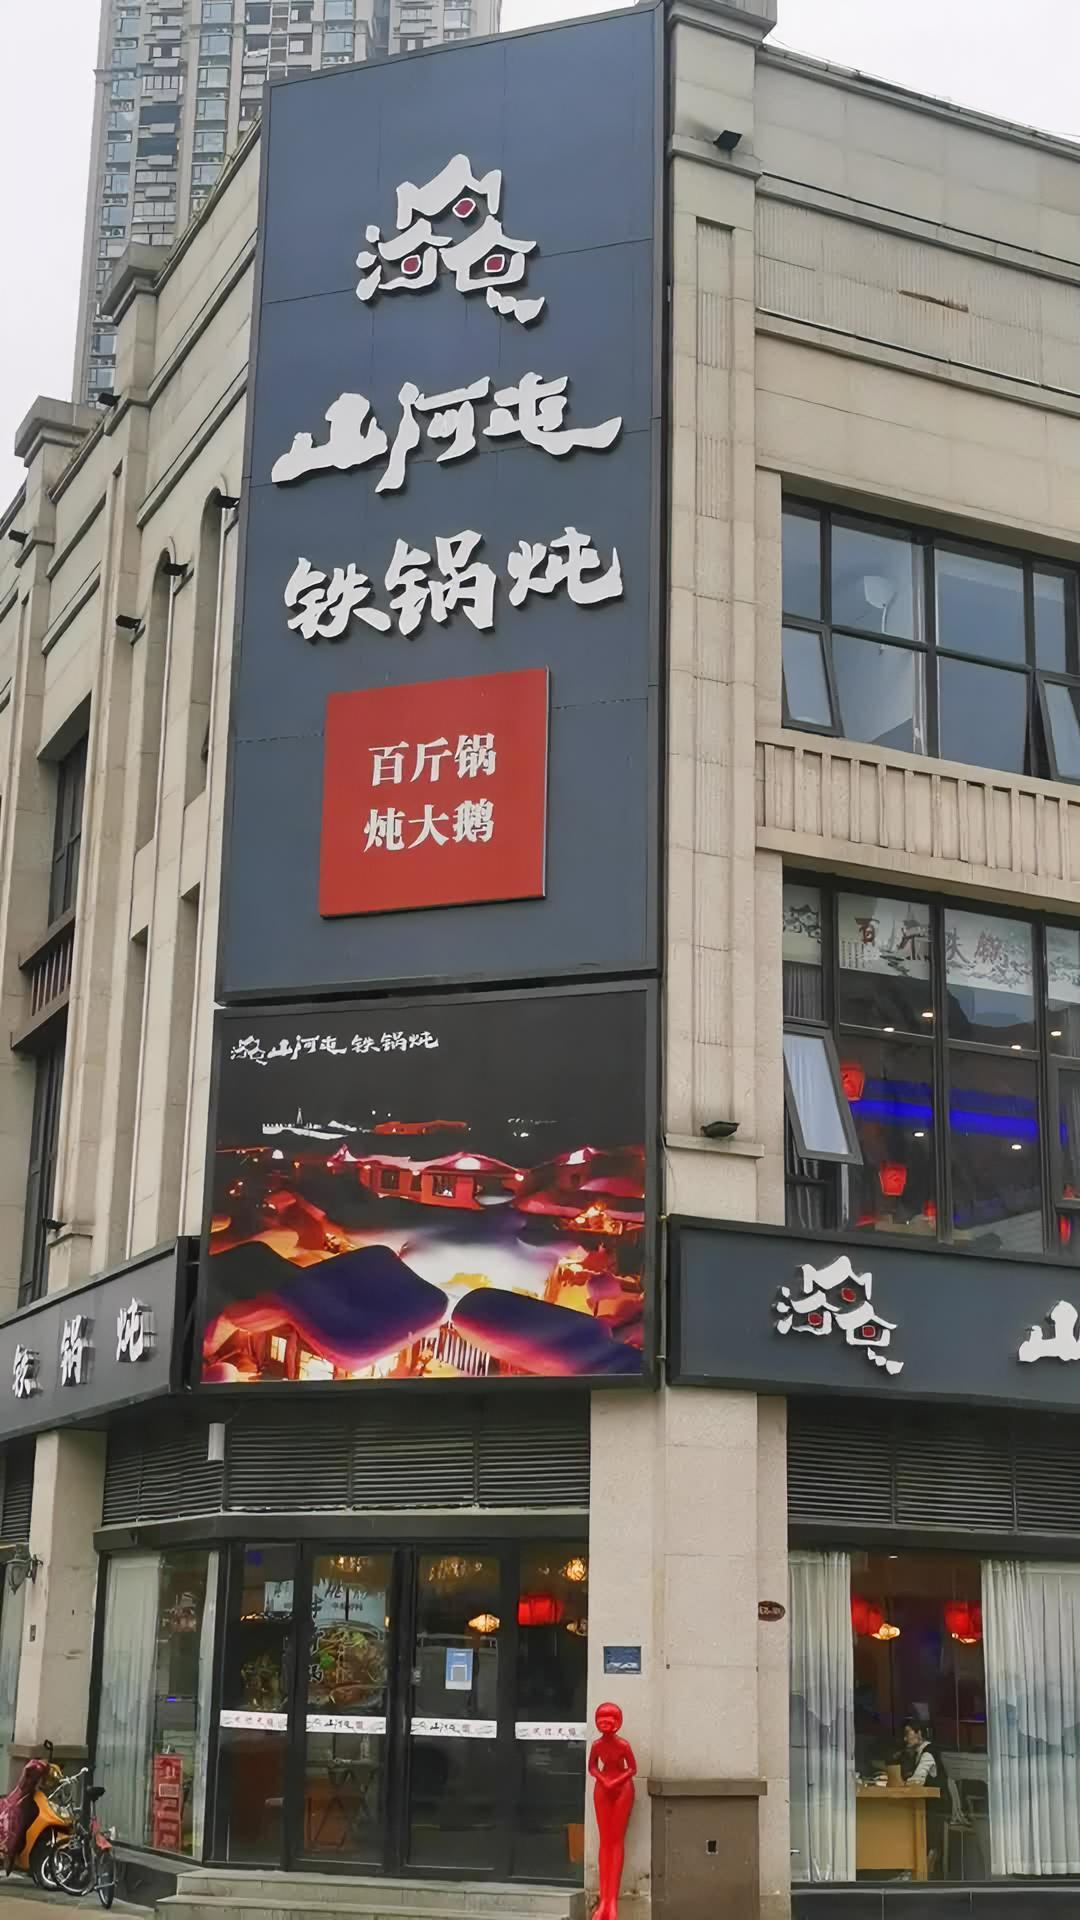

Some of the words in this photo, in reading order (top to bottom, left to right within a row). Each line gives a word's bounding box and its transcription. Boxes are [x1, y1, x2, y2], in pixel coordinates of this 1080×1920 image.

[271, 372, 622, 493] 山河屯
[284, 526, 623, 640] 铁锅炖
[368, 732, 497, 787] 百斤锅
[363, 798, 495, 852] 炖大鹅
[352, 1031, 440, 1054] 铁锅炖
[12, 1296, 152, 1398] 铁锅炖
